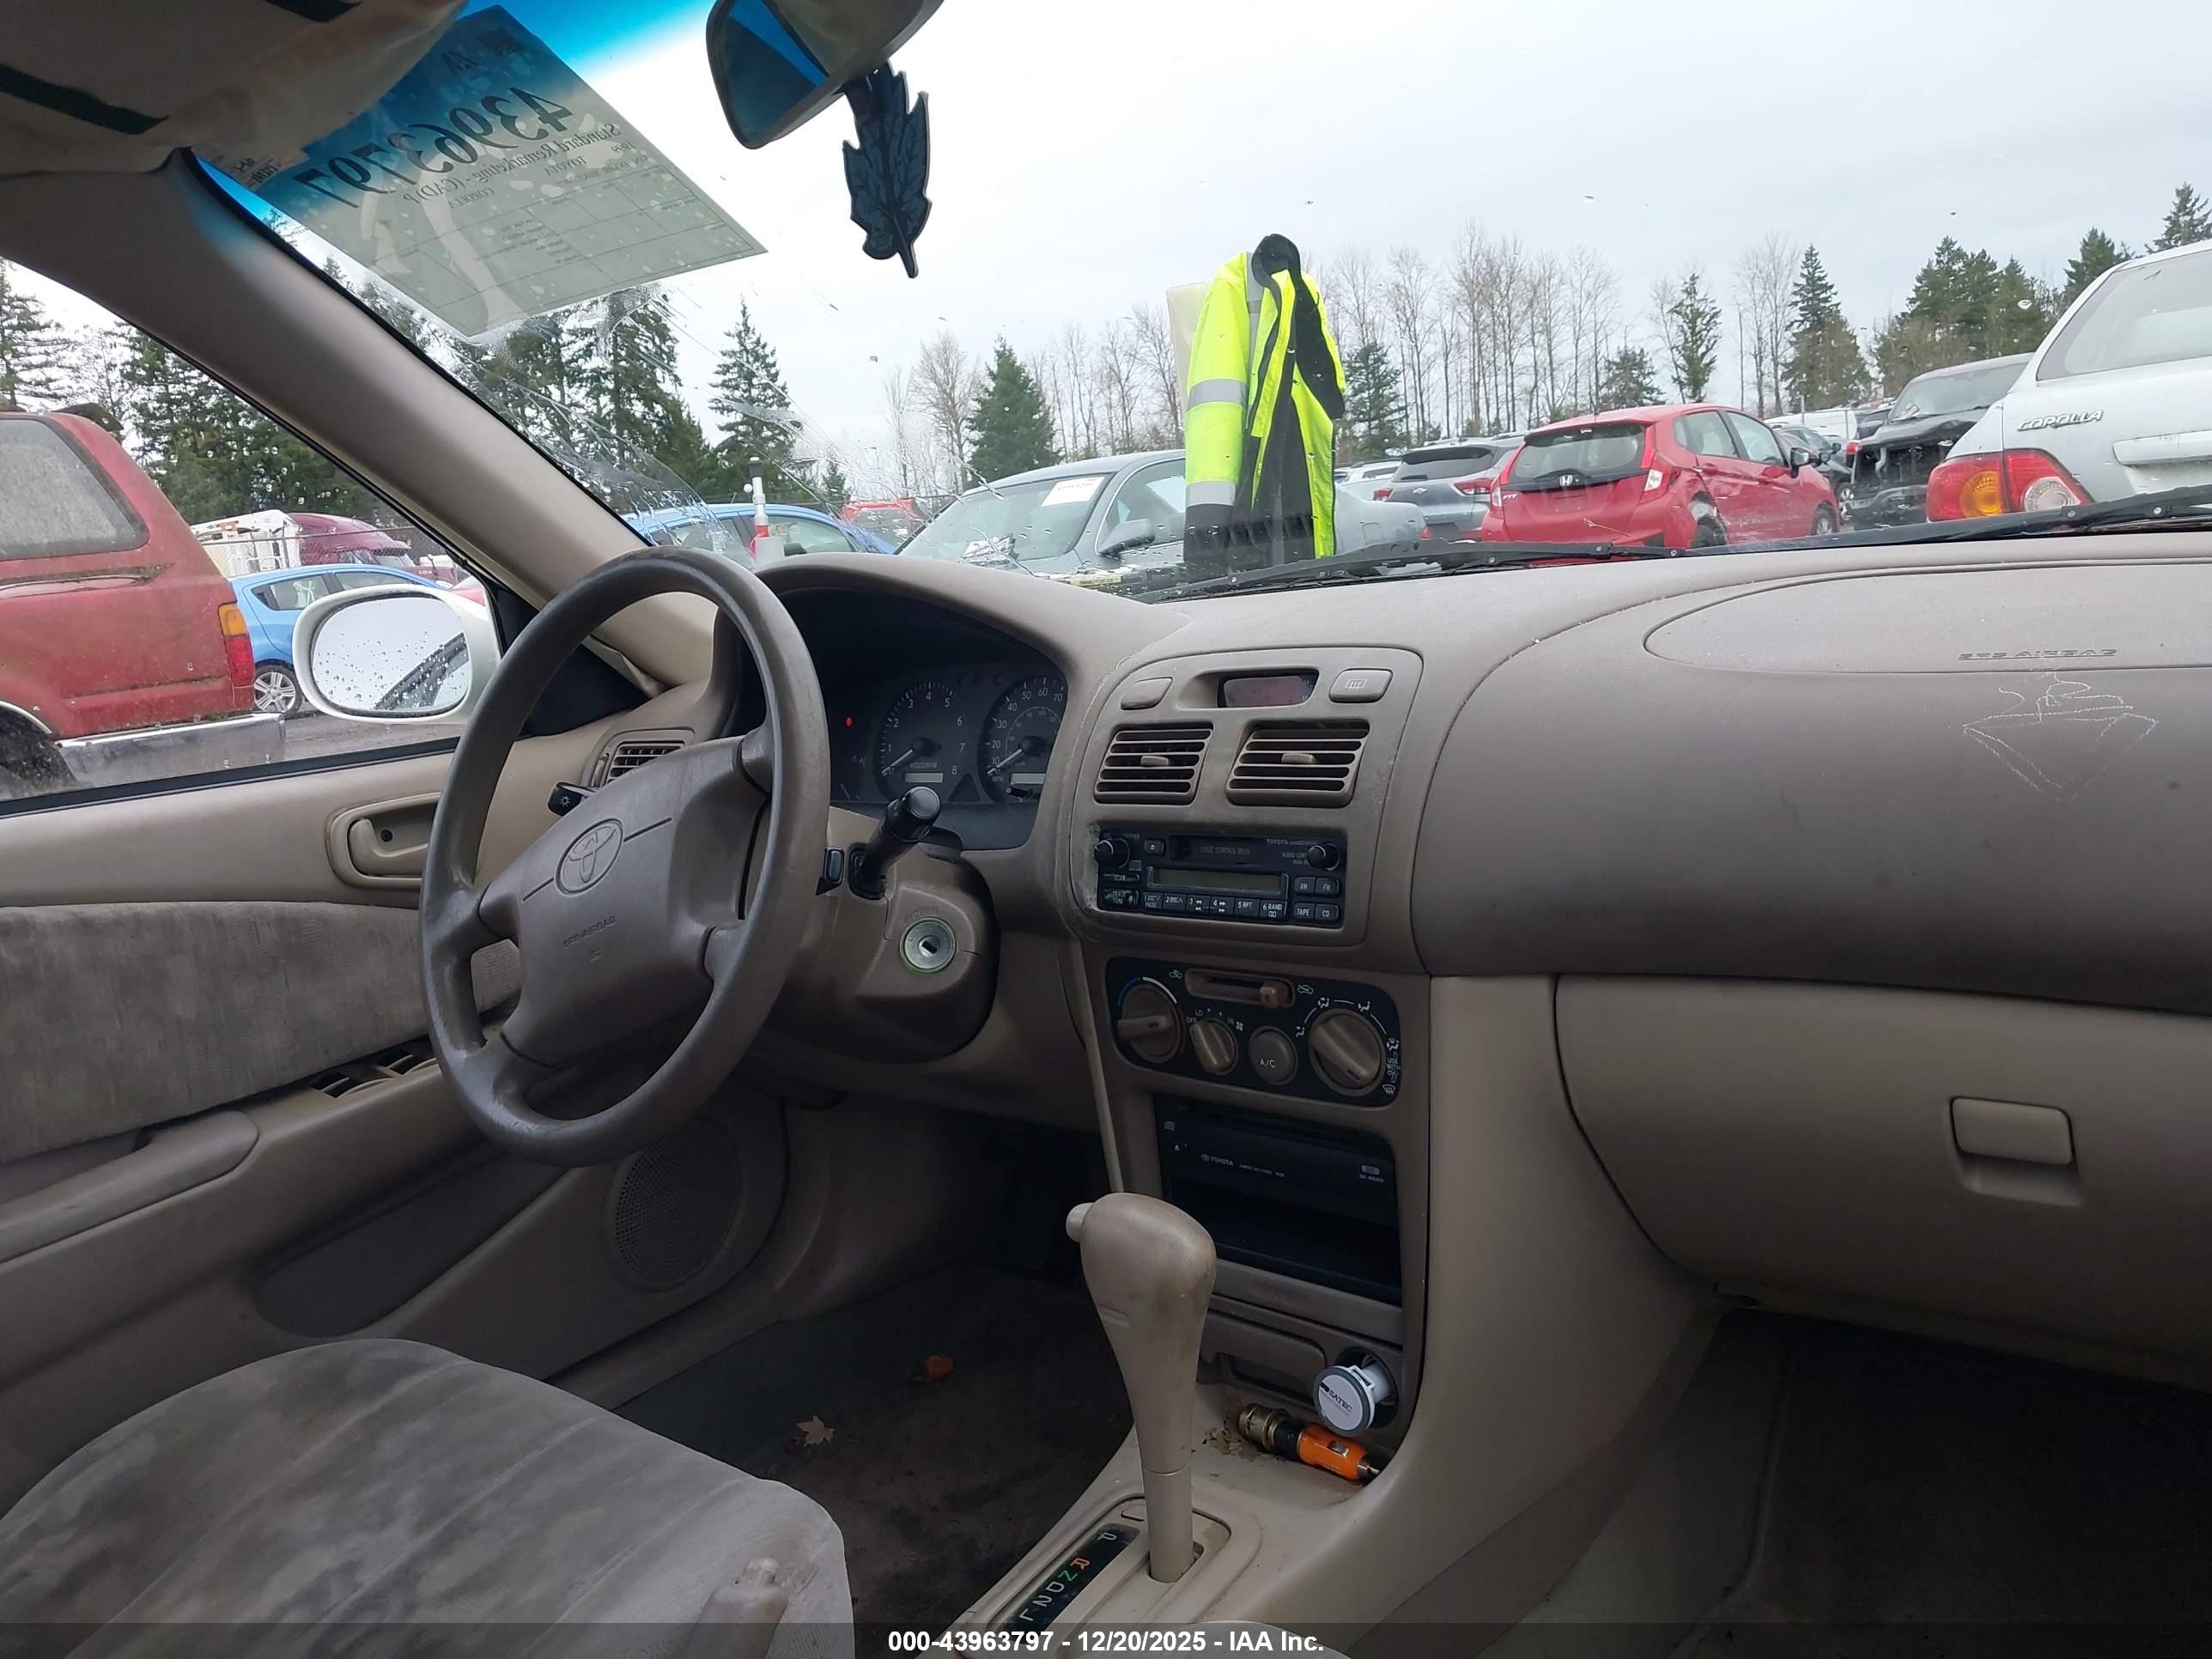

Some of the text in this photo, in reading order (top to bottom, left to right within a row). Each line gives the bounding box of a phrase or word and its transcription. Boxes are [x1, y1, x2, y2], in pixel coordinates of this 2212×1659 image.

[2017, 410, 2104, 432] COROLLA
[926, 691, 932, 700] 4
[1022, 690, 1031, 700] 50
[1037, 687, 1048, 696] 60
[1054, 693, 1063, 702] 70
[908, 699, 914, 708] 3
[945, 697, 950, 708] 5
[1008, 702, 1018, 712] 40
[893, 718, 899, 728] 2
[957, 715, 963, 726] 6
[997, 720, 1007, 729] 30
[960, 743, 965, 752] 7
[991, 740, 1001, 749] 20
[993, 757, 1000, 765] 10
[951, 765, 957, 775] 8
[1299, 882, 1308, 890] AM
[1322, 883, 1331, 891] FM
[1188, 897, 1194, 906] 3
[1262, 902, 1267, 911] 6
[1297, 908, 1310, 916] TAPE
[1322, 909, 1330, 918] CD
[1260, 1057, 1276, 1069] A/C
[1210, 1155, 1234, 1167] TOYOTA
[1097, 1532, 1117, 1541] P
[1070, 1557, 1091, 1570] R
[1057, 1569, 1079, 1582] N
[1045, 1581, 1066, 1593] D
[1031, 1595, 1053, 1607] 2
[1018, 1608, 1035, 1622] L
